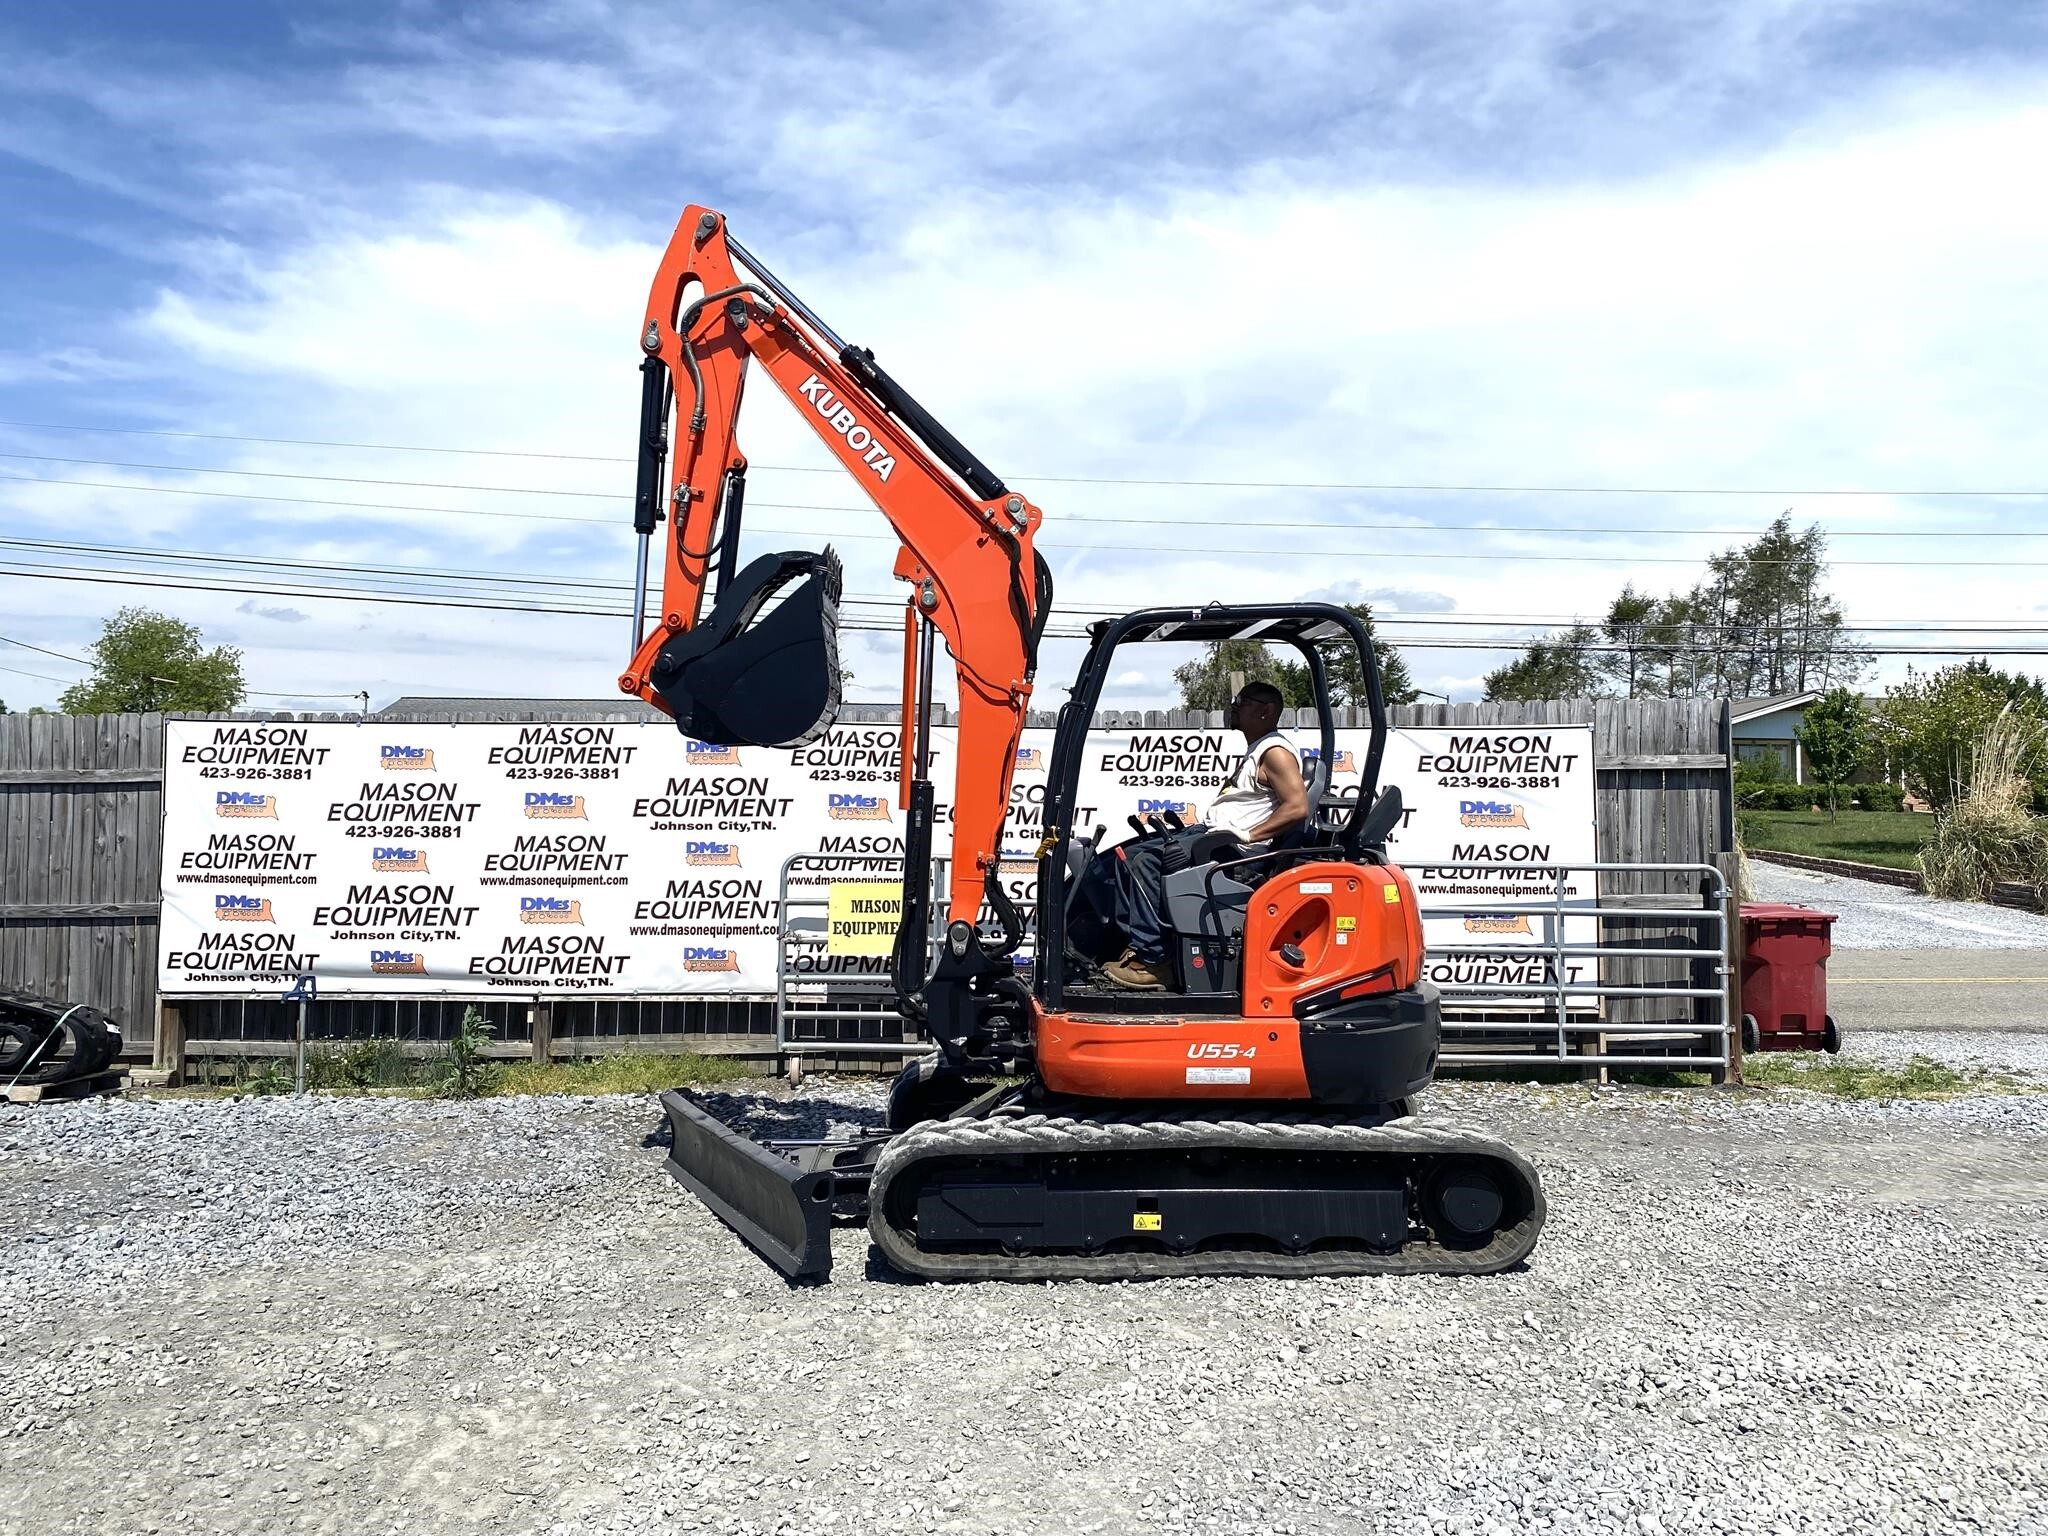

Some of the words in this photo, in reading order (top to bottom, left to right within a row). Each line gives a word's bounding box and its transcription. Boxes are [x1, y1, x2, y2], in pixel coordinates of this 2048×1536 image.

[799, 374, 896, 482] KUBOTA
[213, 728, 307, 745] MASON
[519, 728, 614, 745] MASON
[821, 731, 916, 748] MASO
[1130, 736, 1222, 753] MASON
[1450, 736, 1551, 753] MASON
[182, 746, 330, 765] EQUIPMENT
[488, 747, 637, 764] EQUIPMENT
[791, 750, 940, 768] EQUIPMET
[1100, 754, 1245, 772] EQUIPMENT
[1418, 755, 1578, 773] EQUIPMENT
[200, 767, 311, 780] 423-926-3881
[506, 768, 618, 779] 423-926-3881
[809, 770, 900, 782] 423-926-38
[666, 778, 768, 796] MASON
[1438, 777, 1559, 788] 423-926-3881
[360, 783, 457, 801] MASON
[328, 803, 481, 821] EQUIPMENT
[633, 799, 793, 817] EQUIPMENT
[346, 826, 461, 838] 423-926-3881
[650, 822, 712, 830] Johnson
[719, 821, 776, 832] City,TN.
[208, 834, 295, 851] MASON
[514, 836, 606, 852] MASON
[181, 853, 317, 869] EQUIPMENT
[1452, 845, 1549, 861] MASON
[485, 855, 628, 871] EQUIPMENT
[177, 873, 316, 886] www.dmasonequipment.com
[480, 875, 628, 888] www.dmasonequipment.com
[347, 885, 454, 904] MASON
[666, 880, 762, 898] MASON
[851, 900, 900, 914] MASON
[313, 907, 479, 926] EQUIPMENT
[330, 931, 394, 939] Johnson
[401, 931, 460, 942] City,TN.
[832, 922, 901, 937] EQUIPME
[198, 933, 295, 951] MASON
[501, 936, 604, 954] MASON
[167, 952, 320, 970] EQUIPMENT
[469, 956, 630, 974] EQUIPMENT
[184, 973, 245, 982] Johnson
[250, 974, 301, 983] City,TN
[487, 977, 549, 986] Johnson
[555, 978, 613, 988] City,TN.
[1187, 1044, 1256, 1059] U55-4
